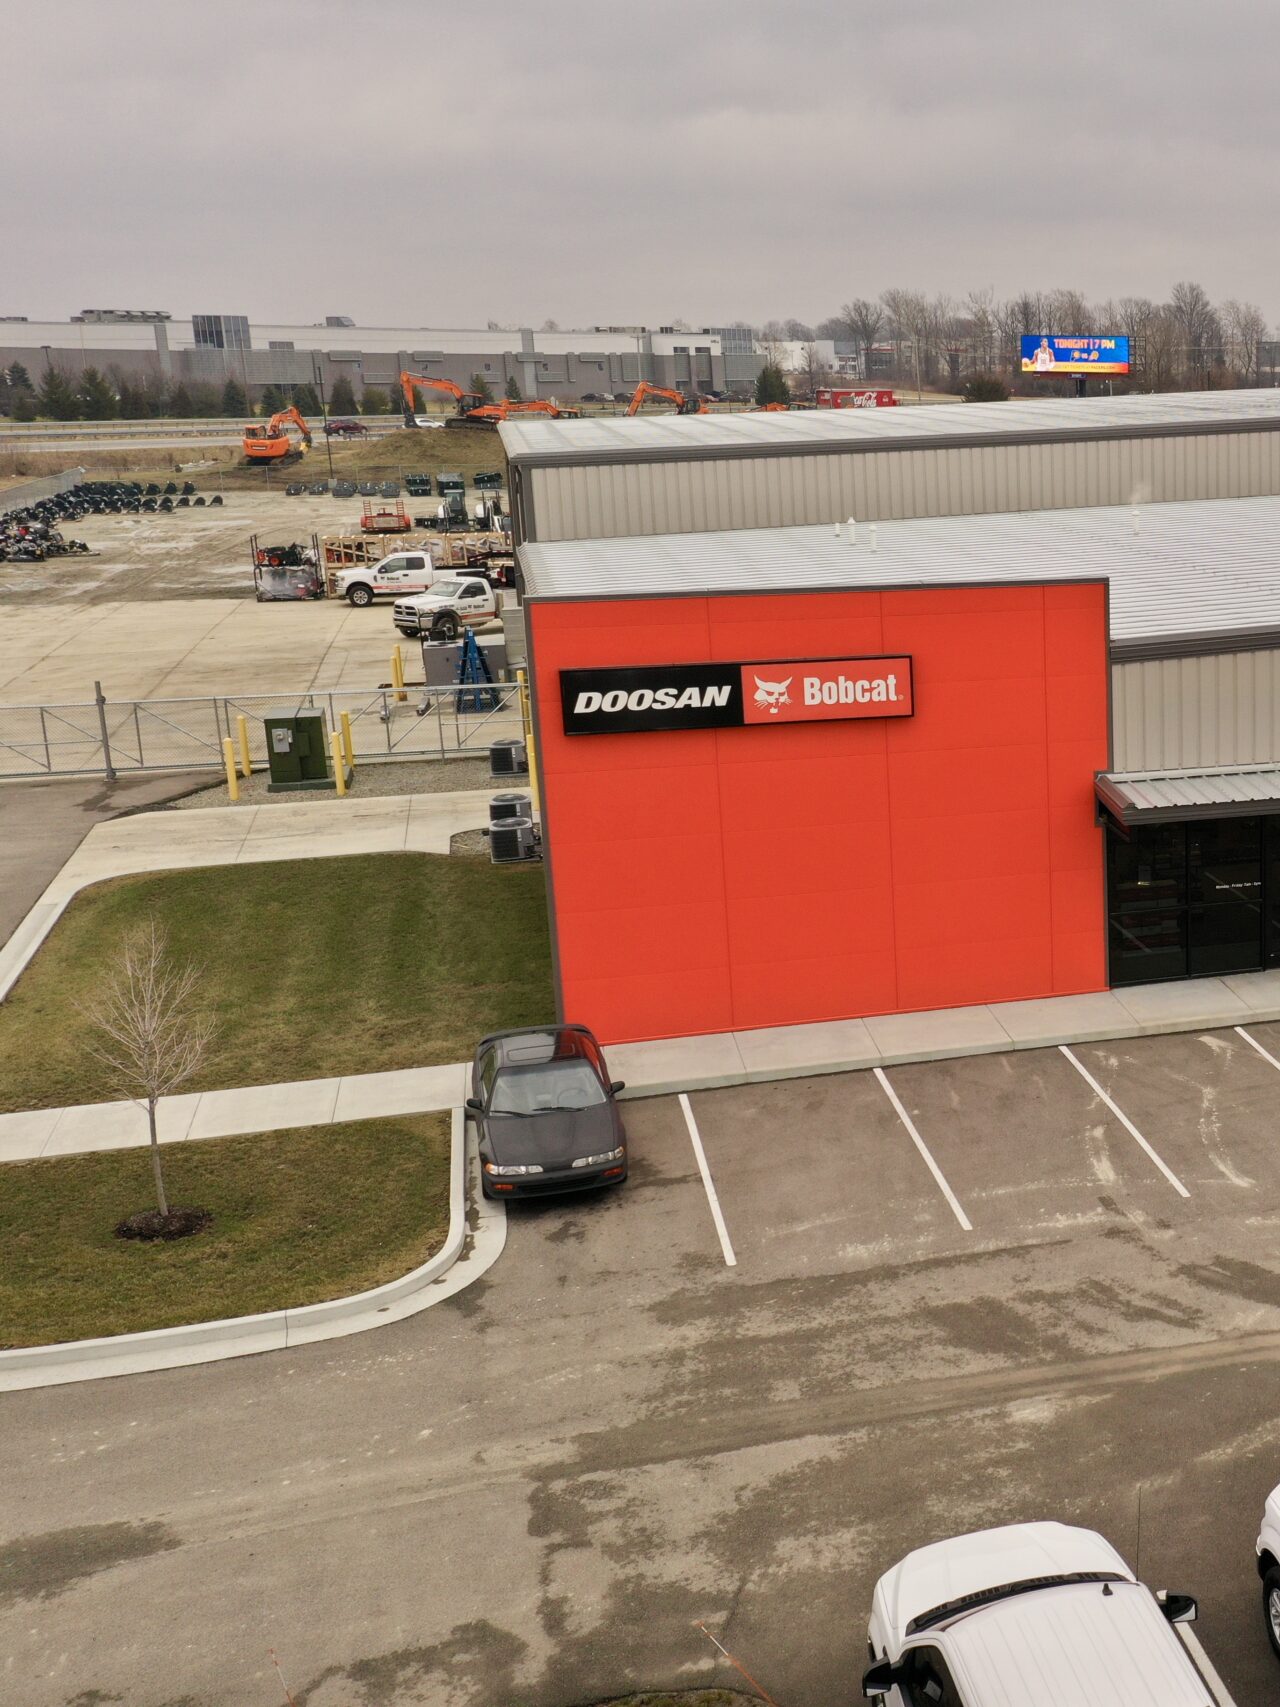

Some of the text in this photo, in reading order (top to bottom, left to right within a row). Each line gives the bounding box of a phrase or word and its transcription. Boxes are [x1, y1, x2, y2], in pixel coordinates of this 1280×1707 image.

[1053, 338, 1115, 349] TONIGHT 7 PM
[573, 674, 898, 714] DOOSAN Bobcat
